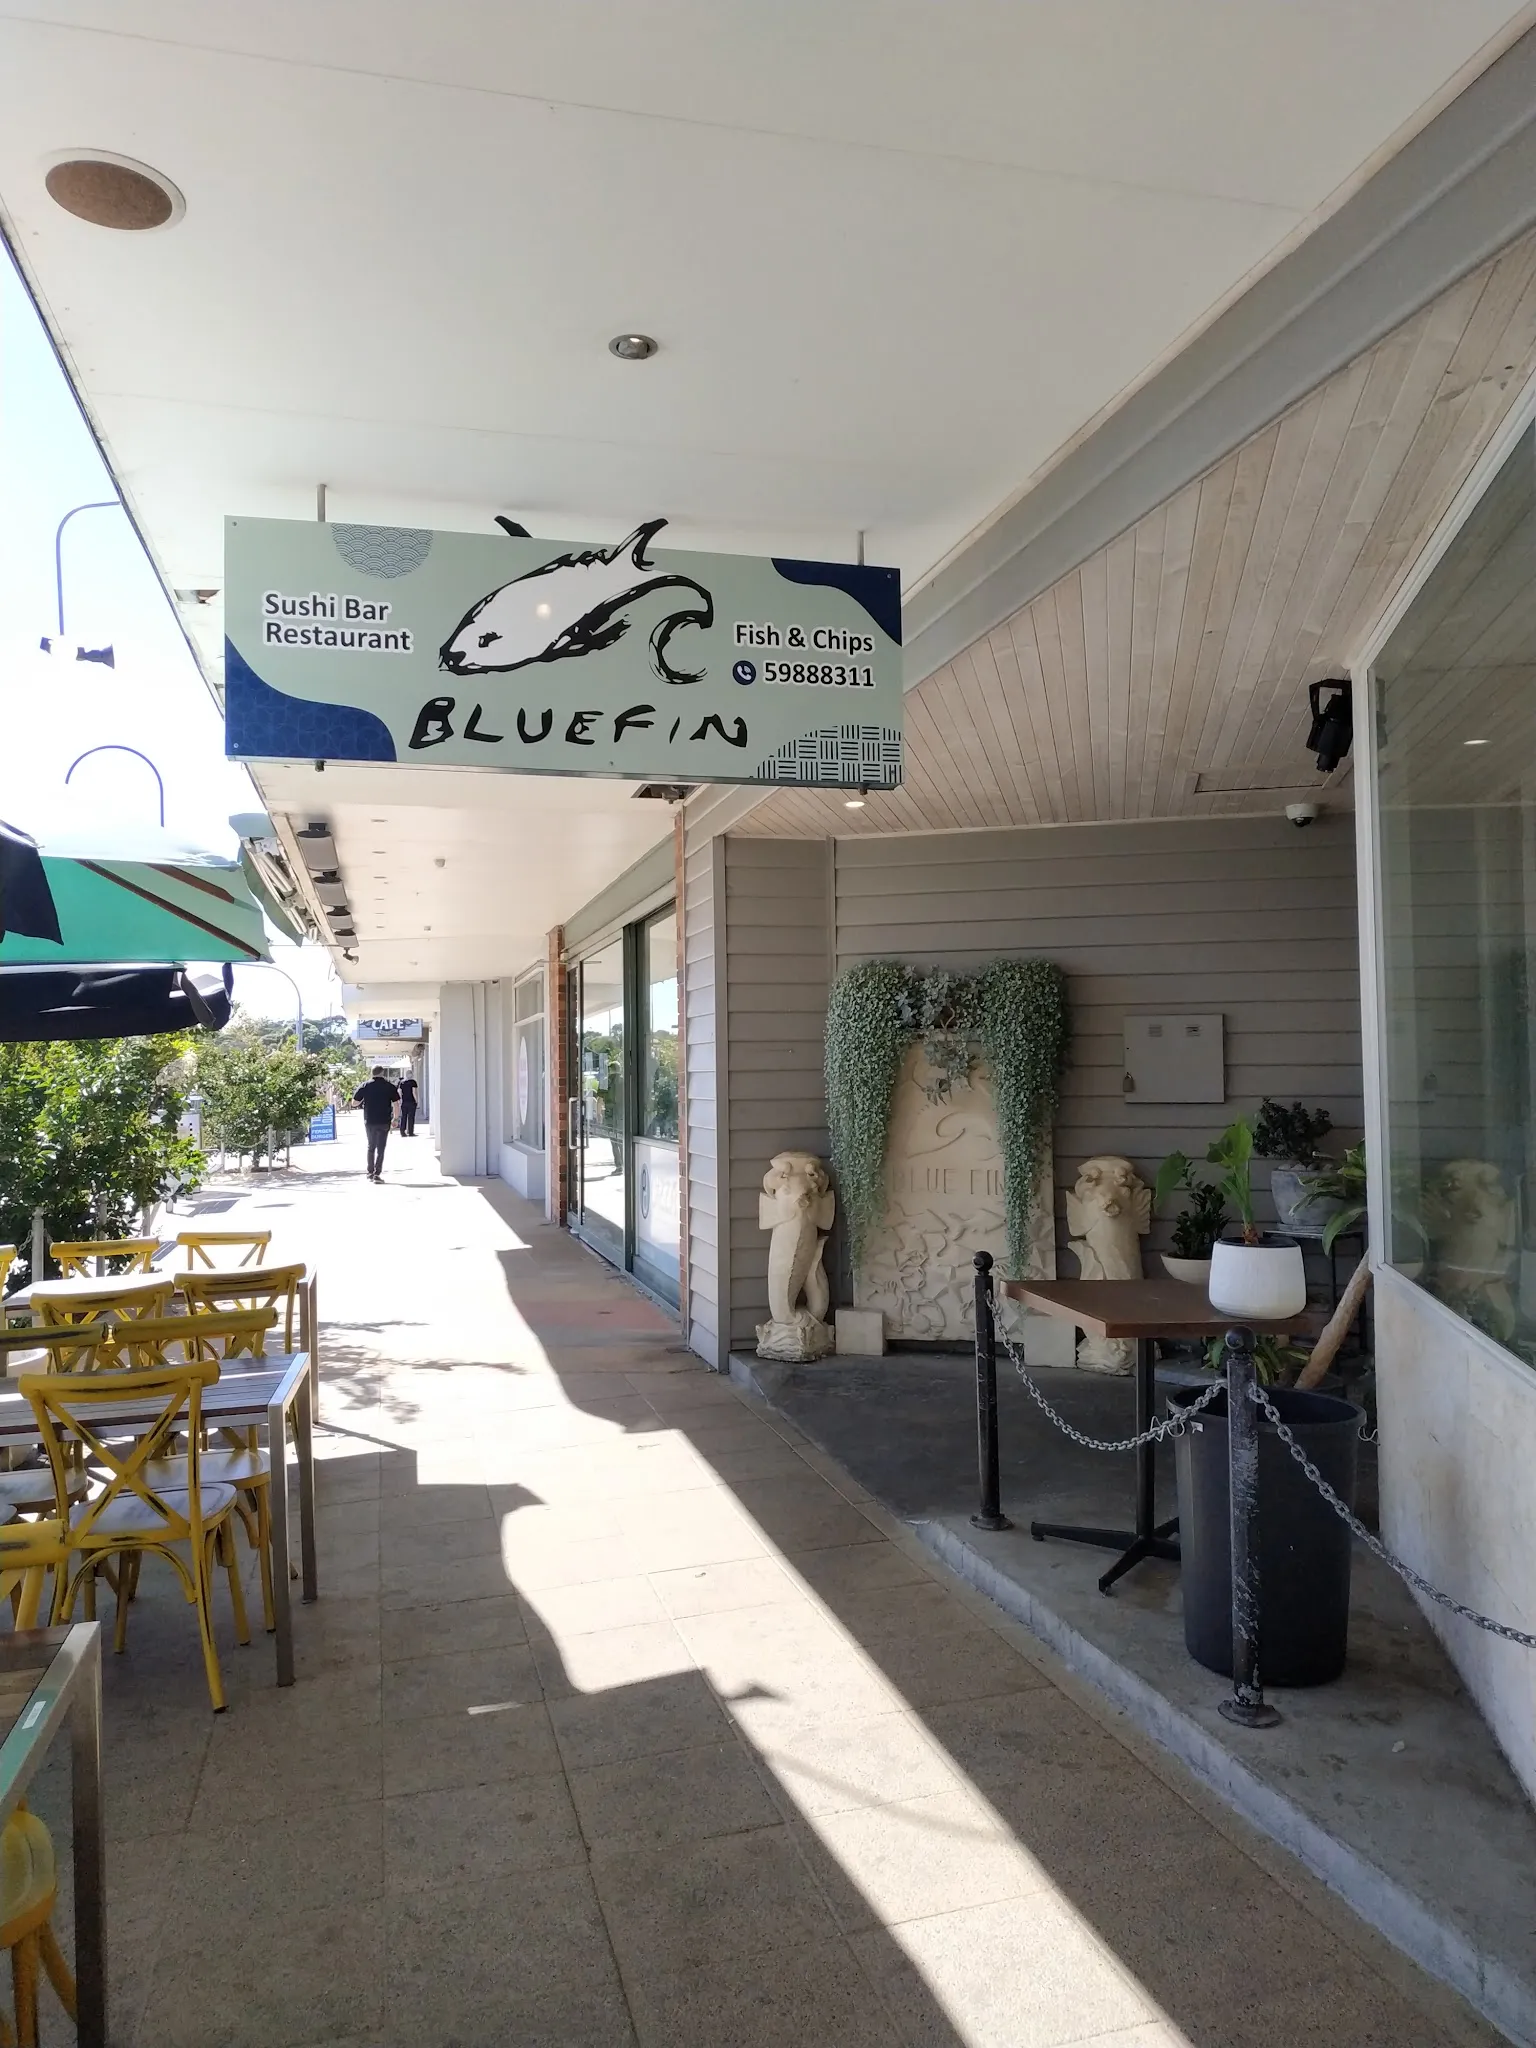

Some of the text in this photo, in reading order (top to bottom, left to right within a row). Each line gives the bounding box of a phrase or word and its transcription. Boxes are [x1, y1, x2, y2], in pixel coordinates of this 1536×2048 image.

[264, 592, 389, 621] Sushi Bar
[265, 621, 412, 651] Restaurant
[735, 623, 874, 655] Fish & Chips
[763, 662, 875, 688] 59888311
[408, 696, 748, 750] BLUEFIN
